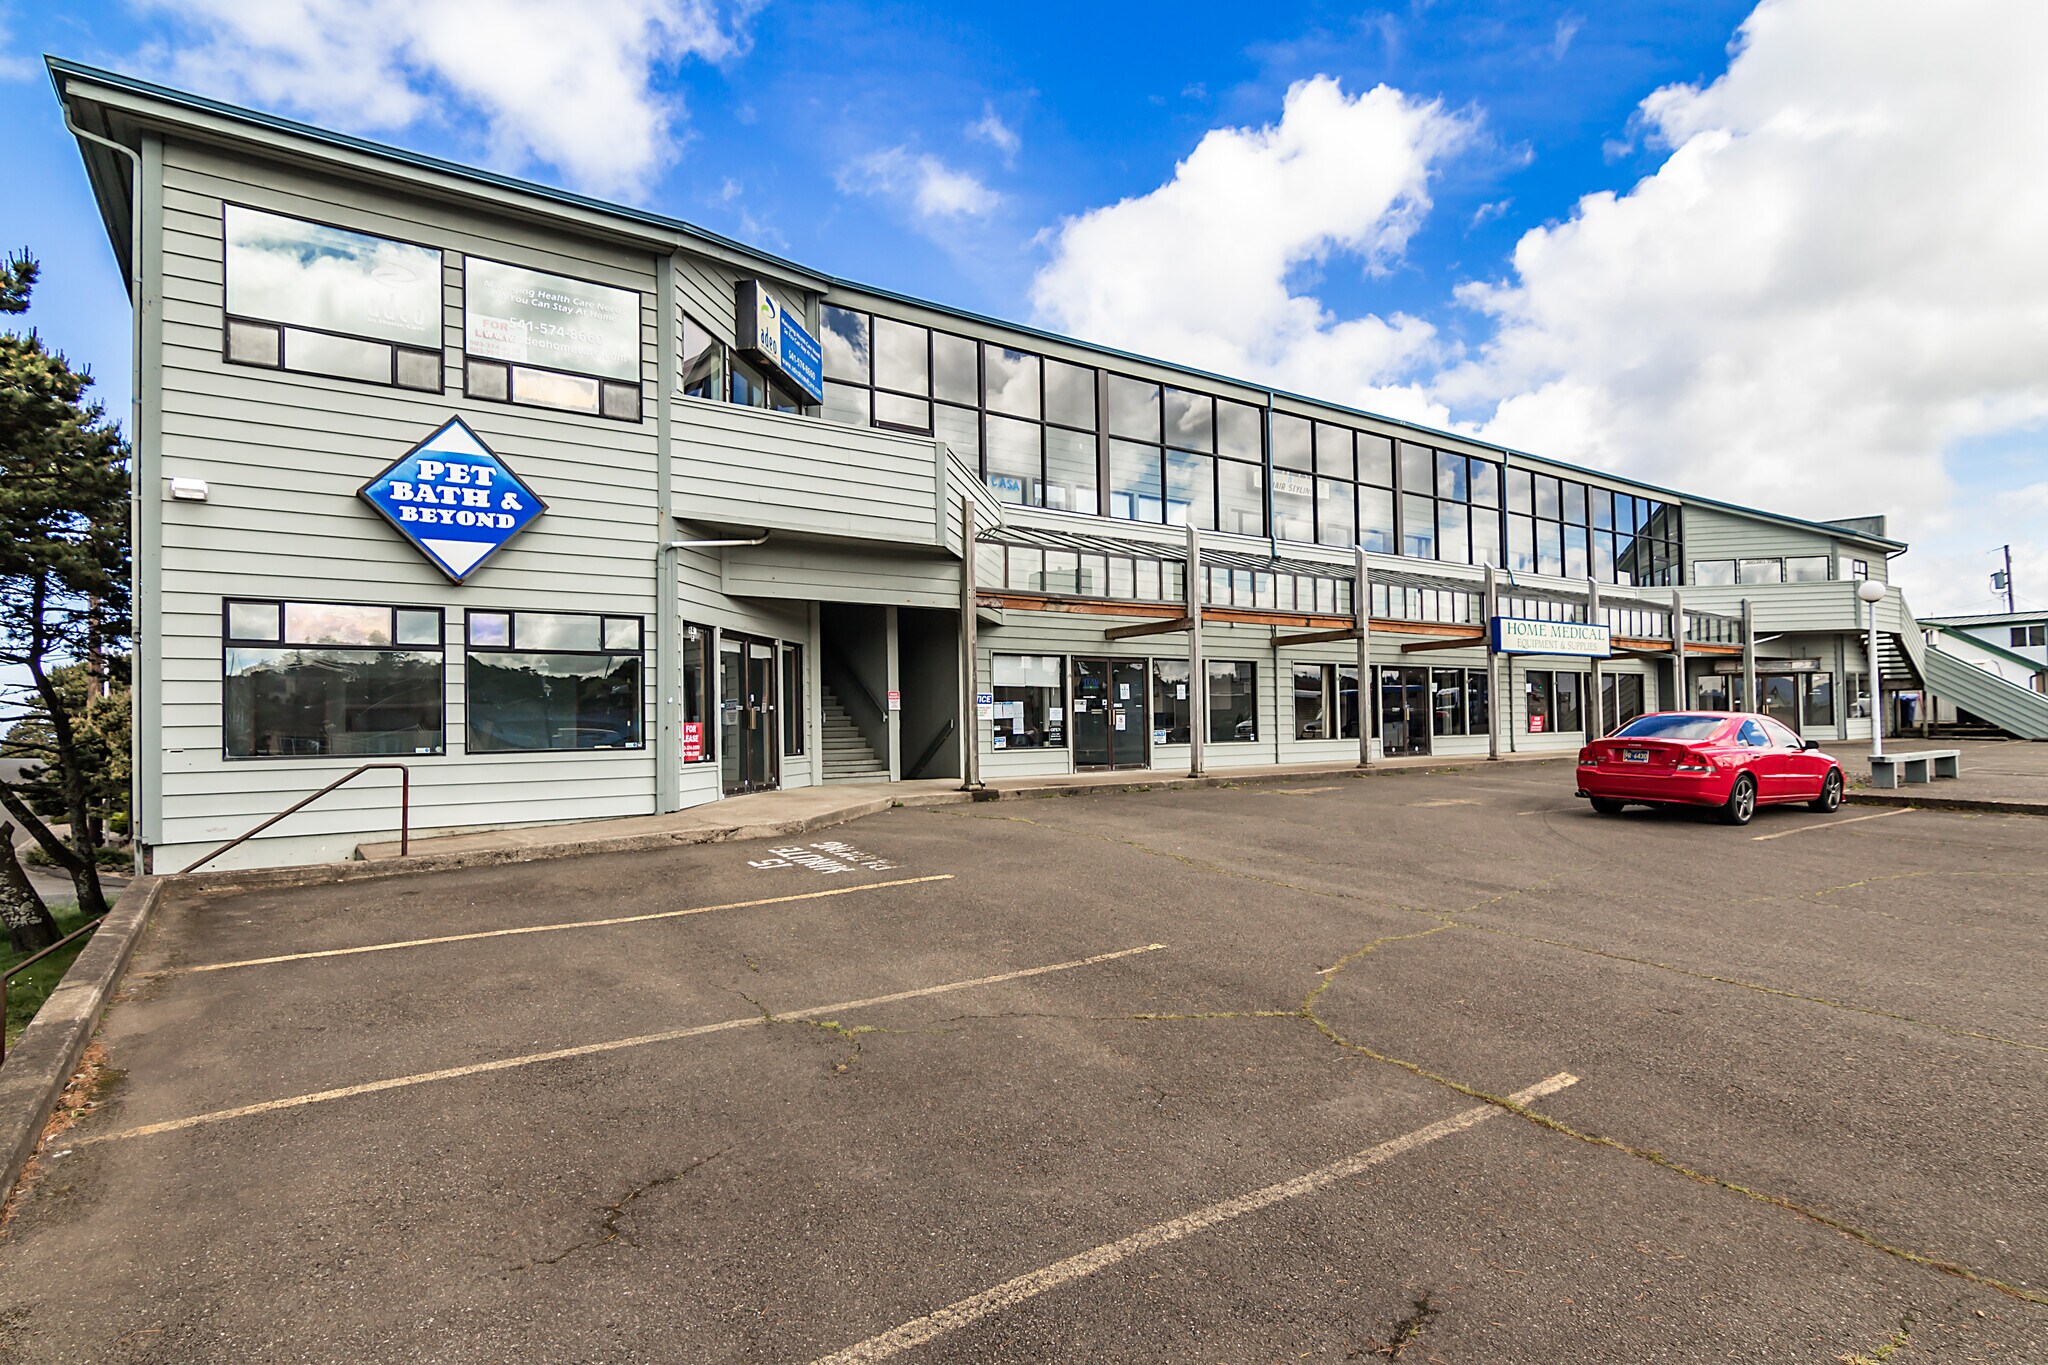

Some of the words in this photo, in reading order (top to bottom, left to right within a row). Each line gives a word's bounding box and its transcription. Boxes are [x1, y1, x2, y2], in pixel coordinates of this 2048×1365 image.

[510, 295, 528, 305] You
[531, 298, 551, 309] Can
[552, 302, 573, 315] Stay
[575, 308, 587, 317] At
[589, 310, 617, 322] Home
[538, 290, 570, 304] Health
[573, 297, 595, 309] Care
[482, 318, 509, 332] FOR
[760, 327, 777, 355] adeo
[416, 459, 497, 487] PET
[991, 474, 1020, 491] CASA
[389, 481, 491, 508] BATH
[500, 492, 523, 511] &
[398, 505, 516, 529] BEYOND
[1507, 622, 1547, 637] HOME
[1551, 625, 1605, 641] MEDICAL
[1517, 638, 1558, 650] EQUIPMENT
[1560, 641, 1566, 650] &
[1568, 641, 1598, 651] SUPPLIES
[684, 734, 699, 743] EASE
[685, 725, 697, 733] FOR
[747, 858, 794, 870] 15
